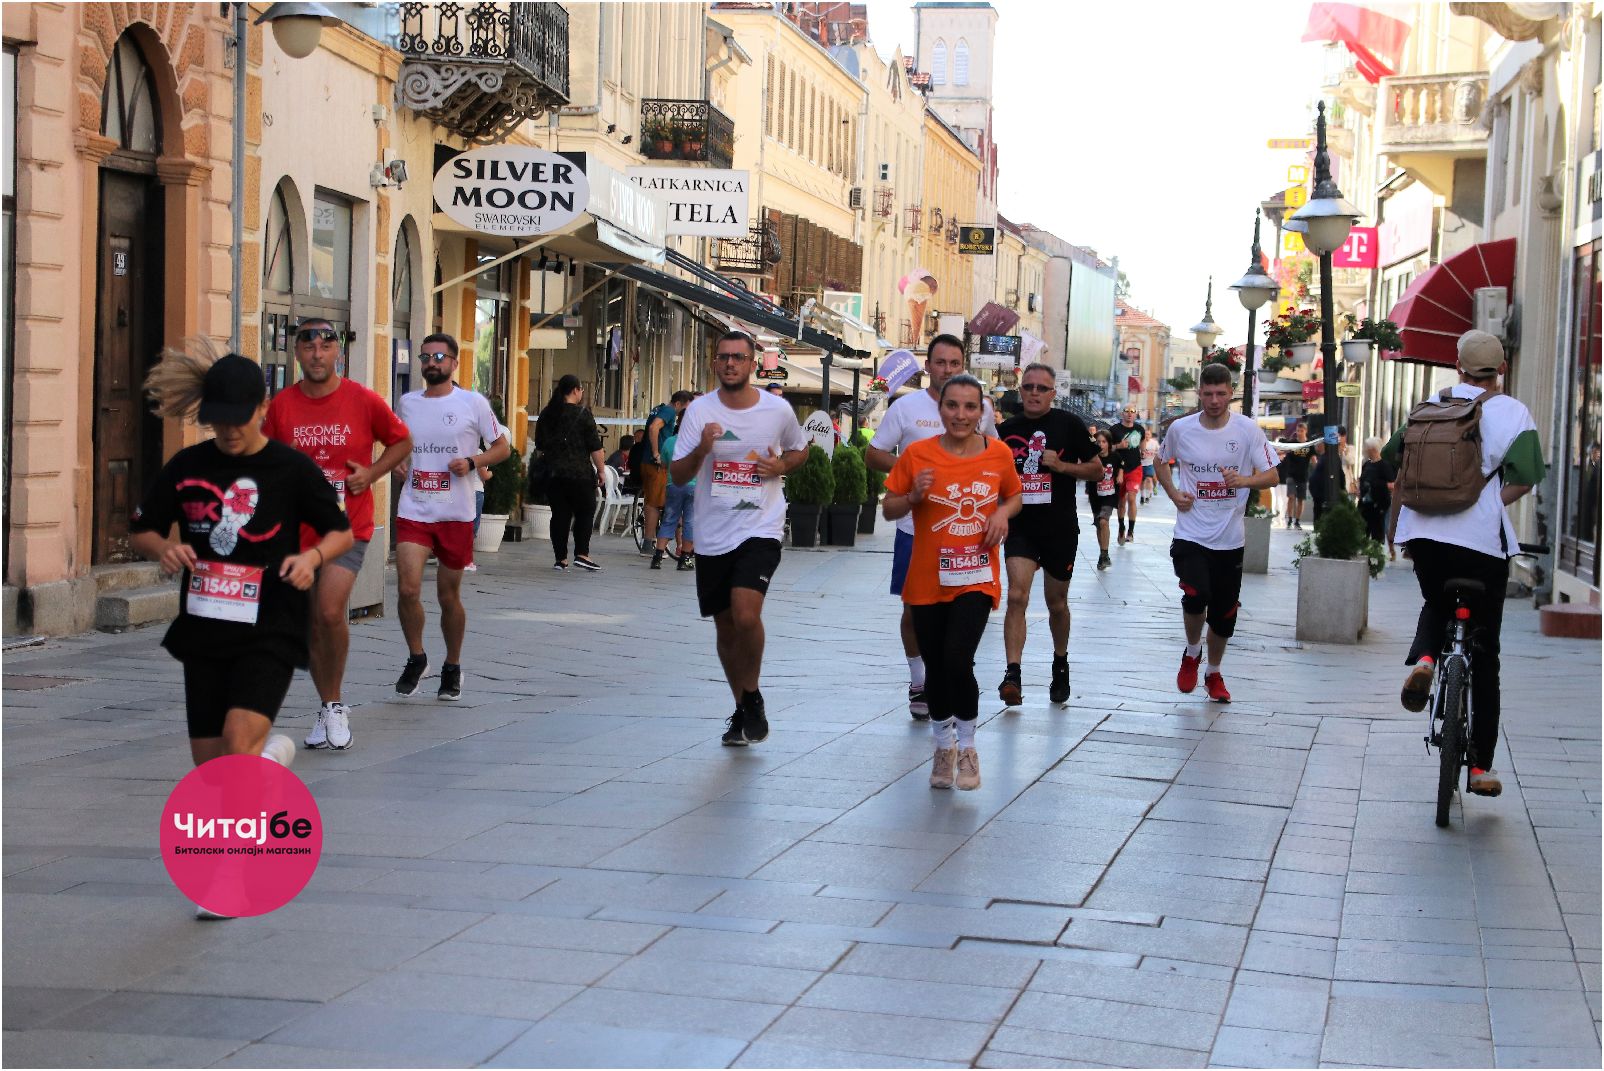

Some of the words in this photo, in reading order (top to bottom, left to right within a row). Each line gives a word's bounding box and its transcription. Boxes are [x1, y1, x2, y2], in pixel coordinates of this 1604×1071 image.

[453, 158, 574, 185] SILVER
[452, 186, 575, 212] MOON
[474, 212, 541, 226] SWAROVSKI
[669, 202, 738, 224] TELA
[475, 224, 541, 232] ELEMENTS
[293, 424, 341, 438] BECOME
[343, 424, 351, 434] A
[298, 435, 346, 447] WINNER
[724, 471, 751, 483] 2054
[420, 480, 438, 489] 1615
[1022, 482, 1041, 491] 1987
[1207, 489, 1227, 497] 1648
[949, 521, 982, 536] BITOLA
[951, 555, 979, 569] 1548
[203, 577, 241, 595] 1549
